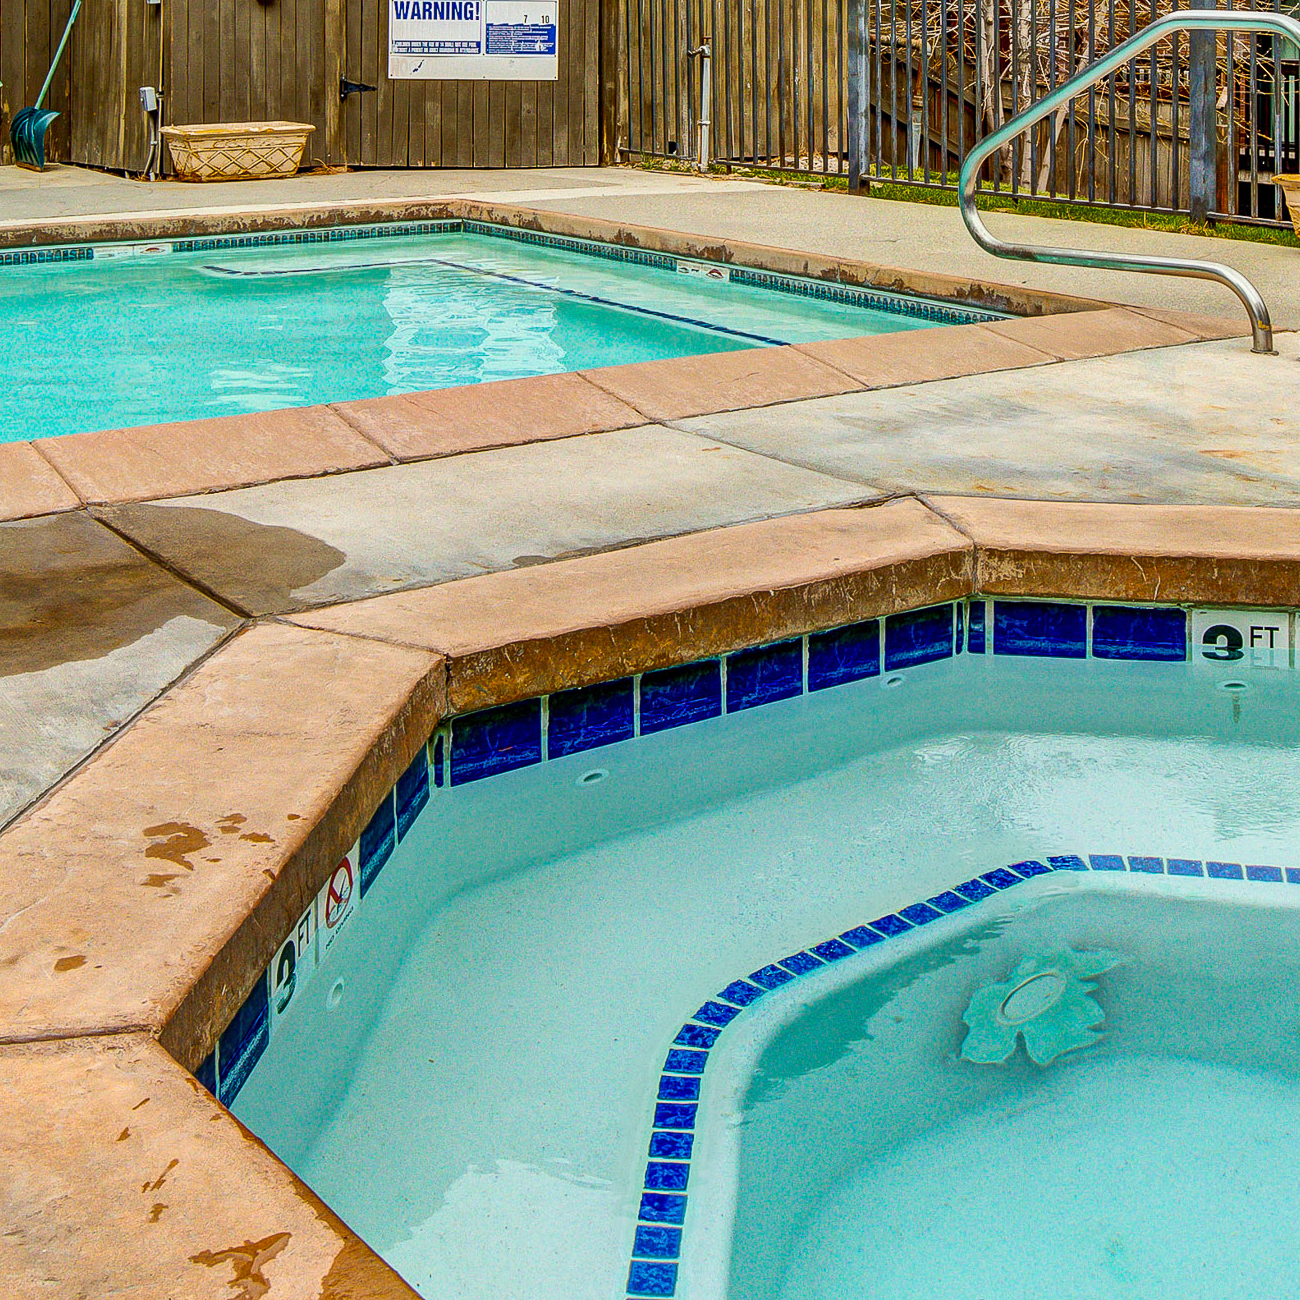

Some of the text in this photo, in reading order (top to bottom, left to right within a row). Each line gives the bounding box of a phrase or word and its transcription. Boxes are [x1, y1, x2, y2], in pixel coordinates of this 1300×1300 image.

[393, 0, 480, 21] WARNING!
[523, 14, 550, 24] 7 10
[1202, 624, 1279, 661] 3 FT
[276, 908, 312, 1015] 3 FT
